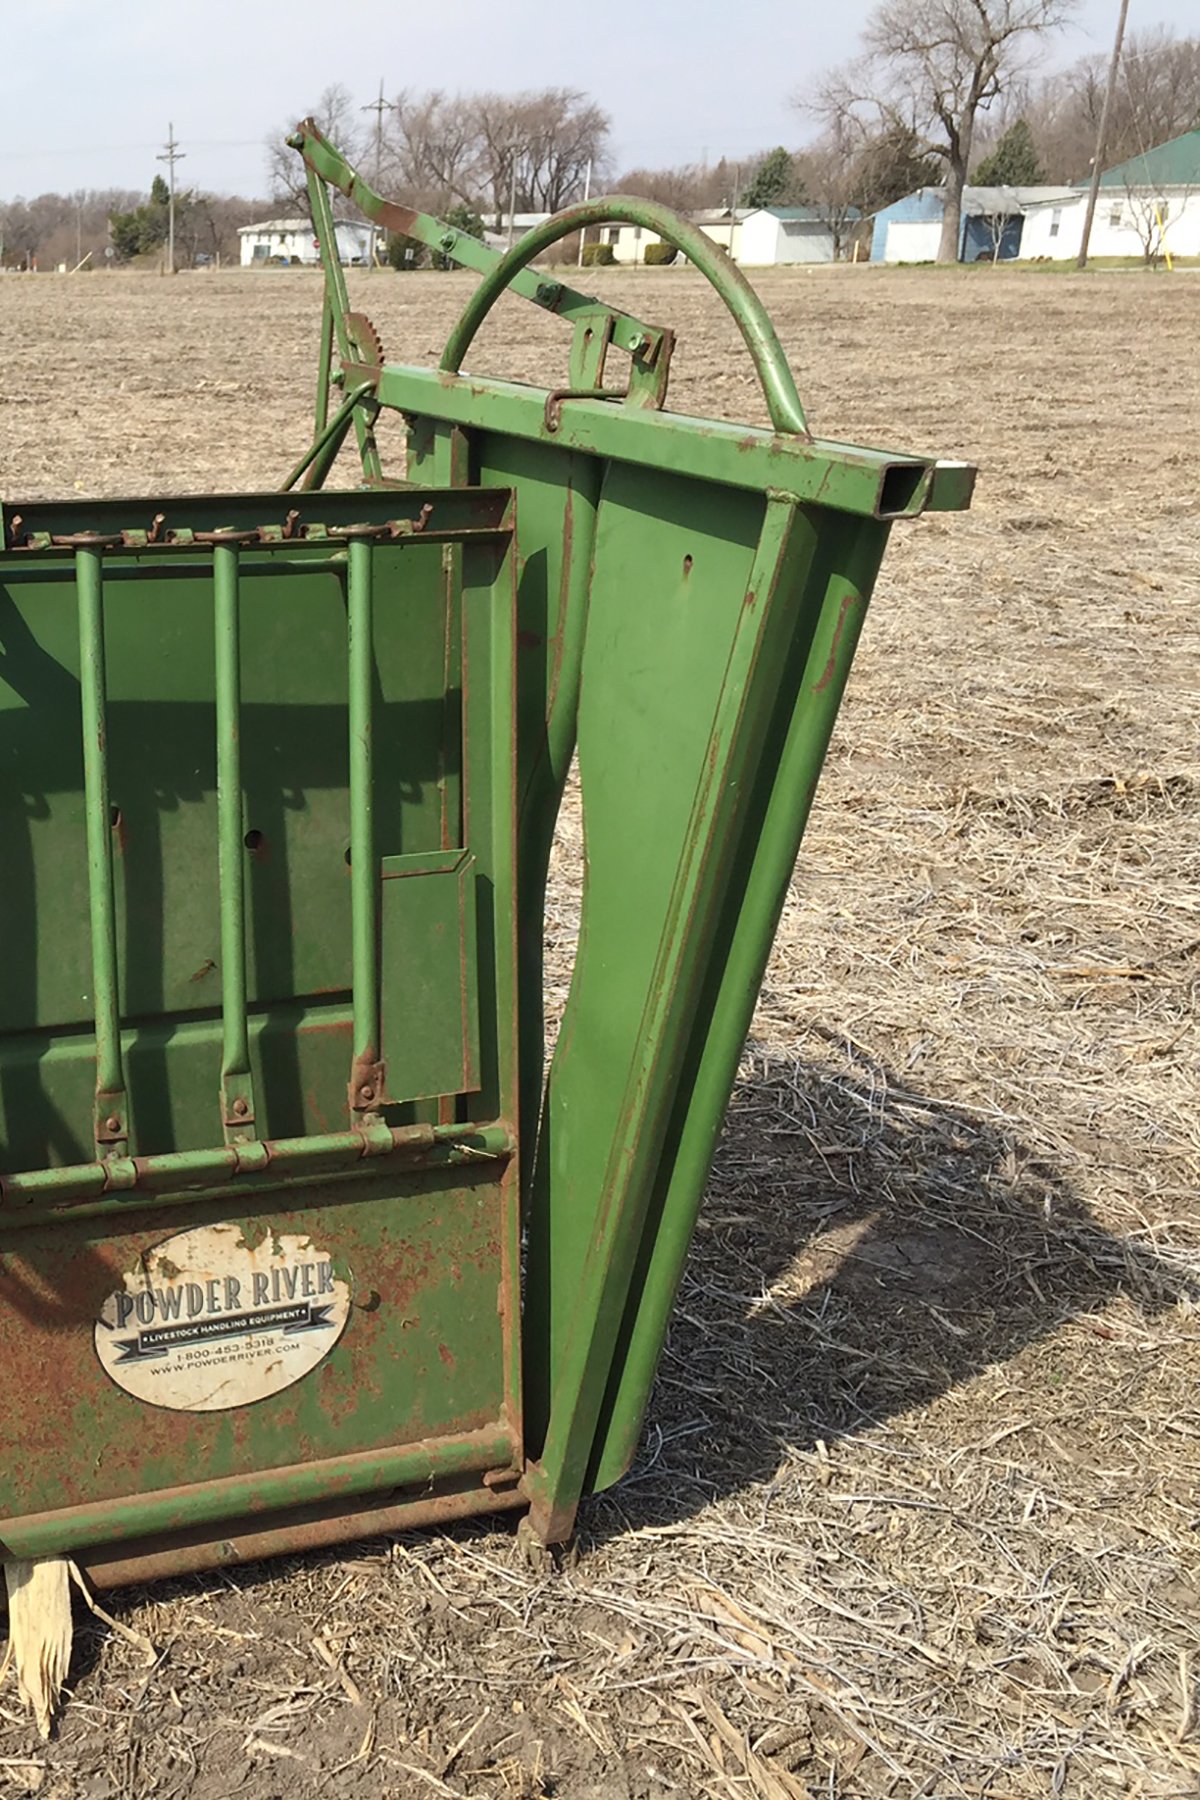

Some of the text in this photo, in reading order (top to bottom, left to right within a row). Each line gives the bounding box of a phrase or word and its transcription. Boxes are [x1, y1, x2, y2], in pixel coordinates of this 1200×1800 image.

[114, 1260, 335, 1329] POWDER RIVER
[148, 1310, 300, 1343] LIVESTOCK HANDLING EQUIPMENT
[150, 1343, 300, 1376] WWW.POWDERRIVER.COM
[176, 1338, 275, 1362] 1-800-453-5318
